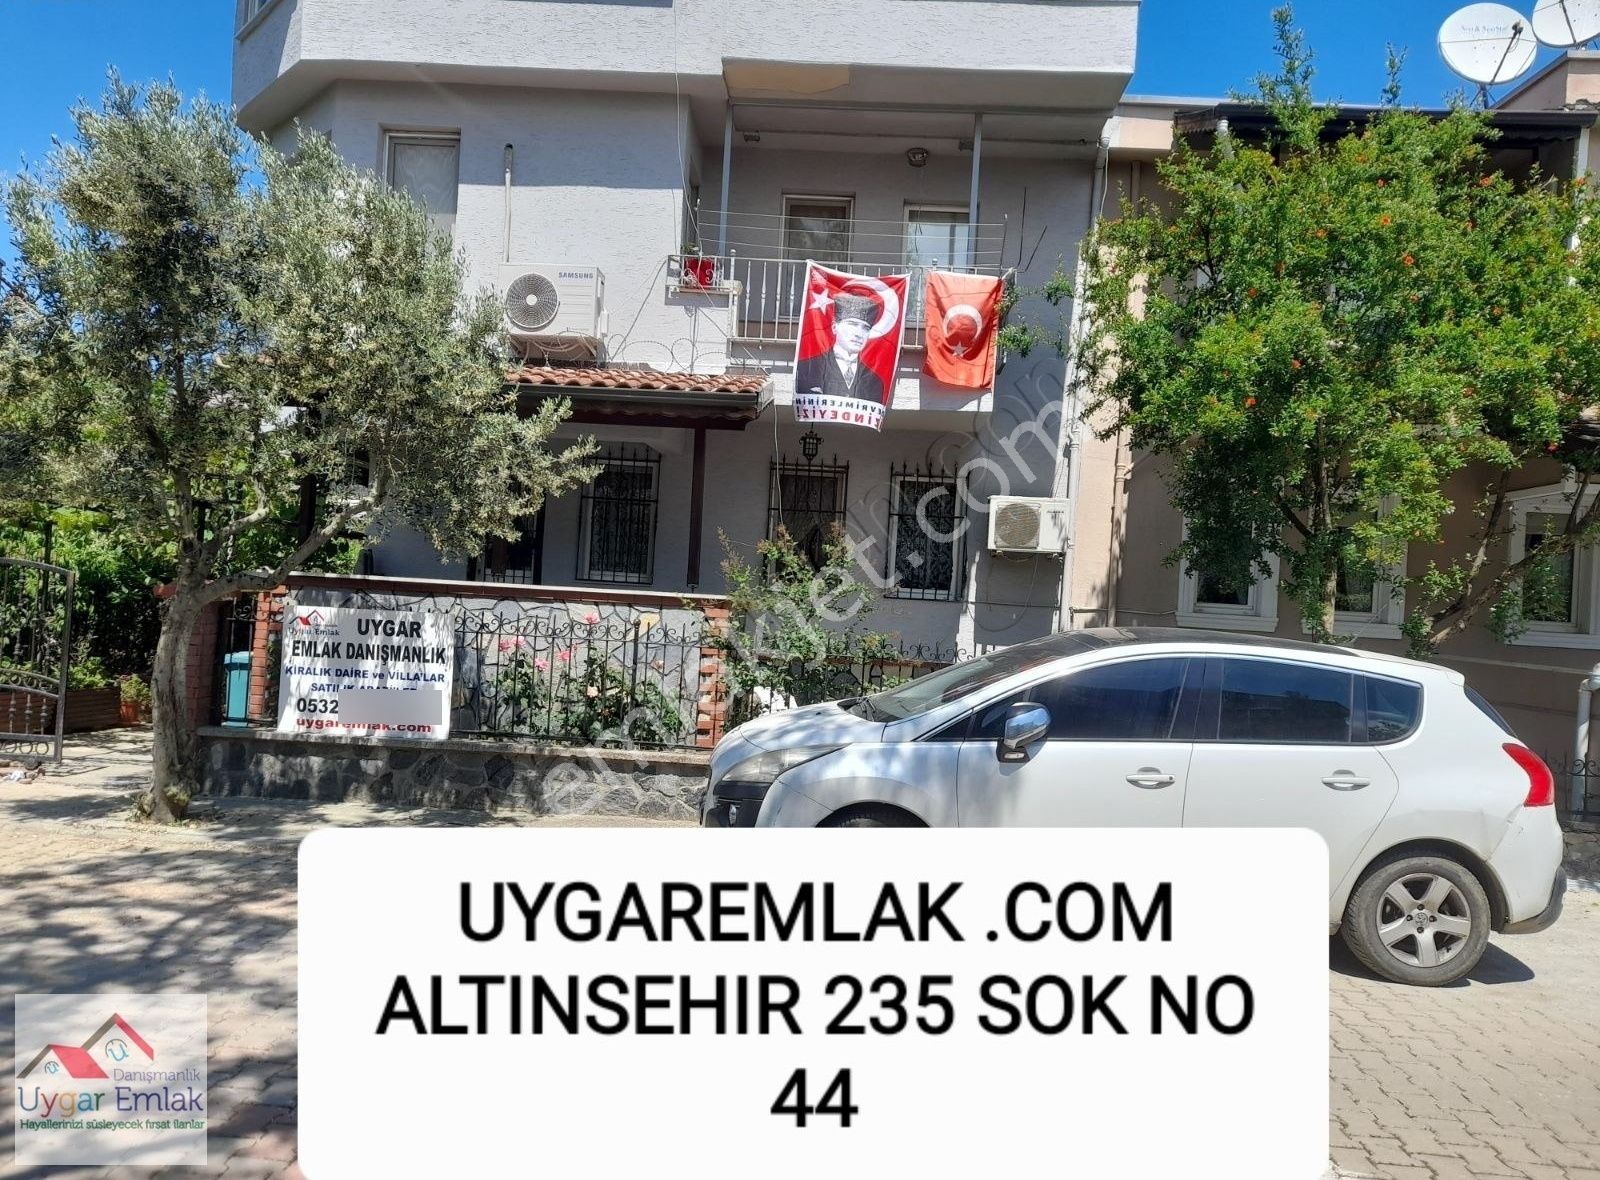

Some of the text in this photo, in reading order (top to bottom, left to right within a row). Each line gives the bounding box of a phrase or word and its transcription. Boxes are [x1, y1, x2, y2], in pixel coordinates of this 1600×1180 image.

[357, 618, 421, 638] UYGAR
[291, 640, 446, 665] EMLAK DANIŞMANLIK
[285, 664, 445, 683] KİRALIK DAİRE ve VİLLA'LAR
[296, 697, 339, 714] 0532
